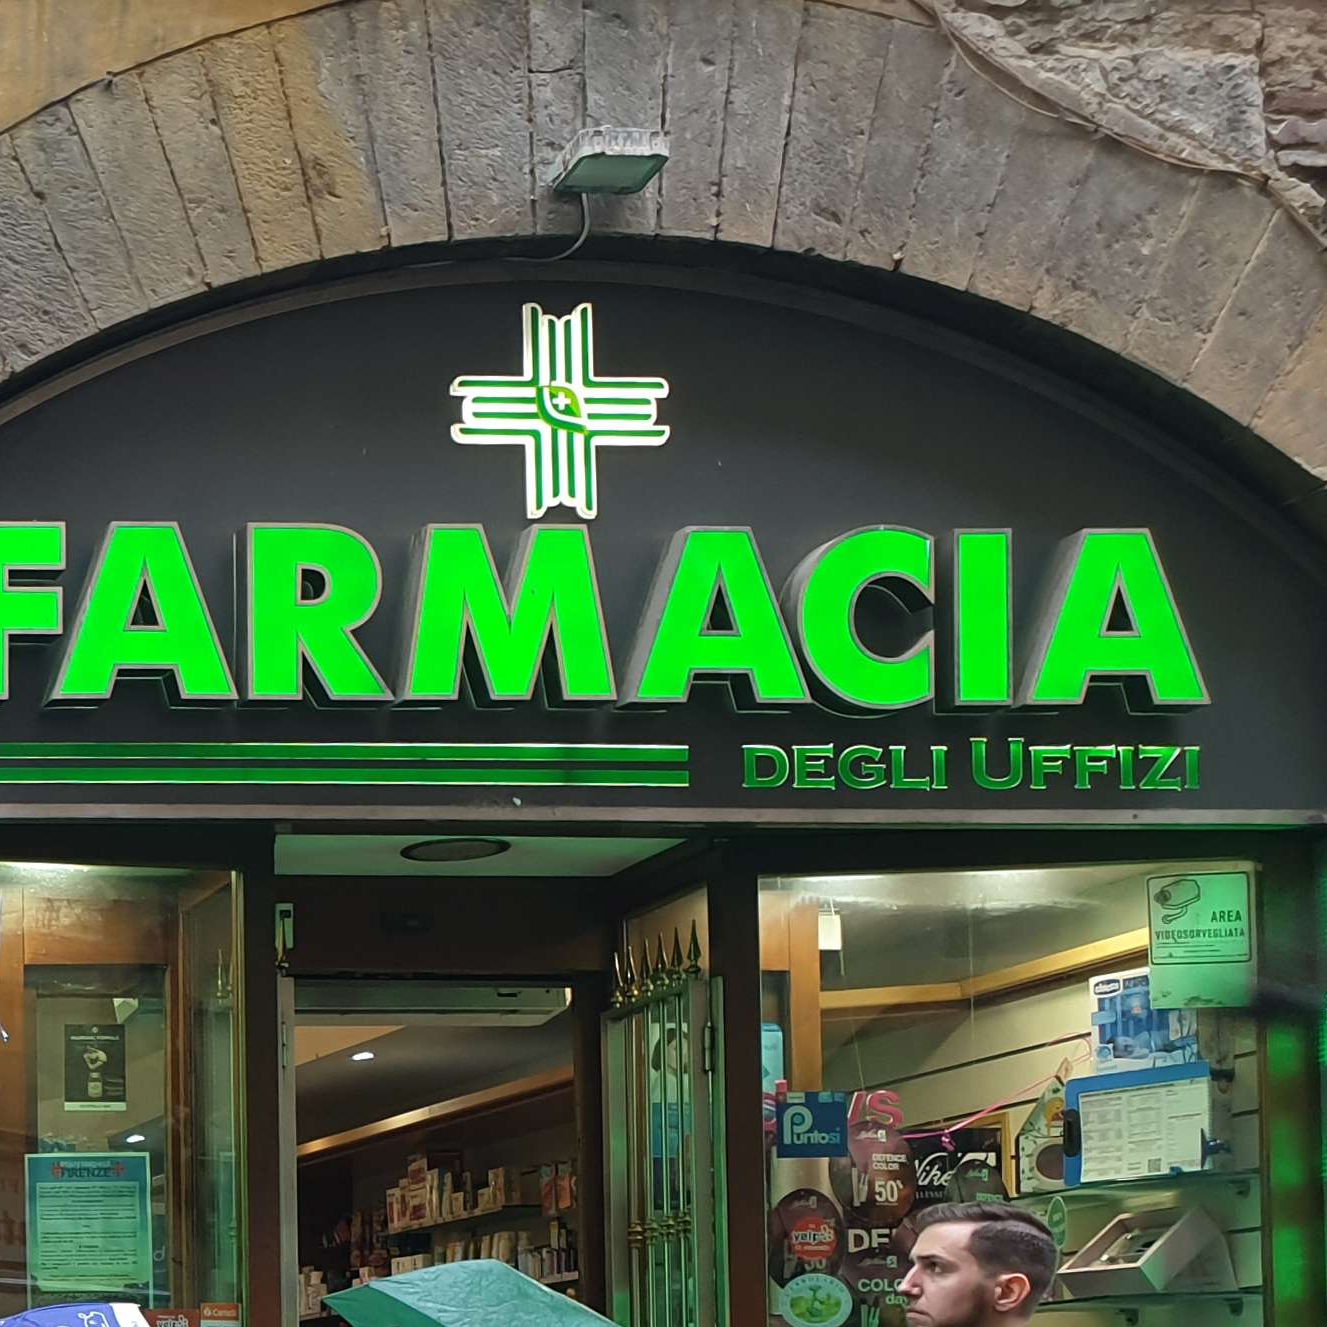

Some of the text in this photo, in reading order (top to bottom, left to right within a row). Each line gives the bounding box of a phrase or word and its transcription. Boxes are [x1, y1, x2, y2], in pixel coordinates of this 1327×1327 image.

[741, 743, 949, 791] DEGLI
[1210, 910, 1242, 923] AREA
[1154, 928, 1246, 941] VIDEOSORVEGLIATA
